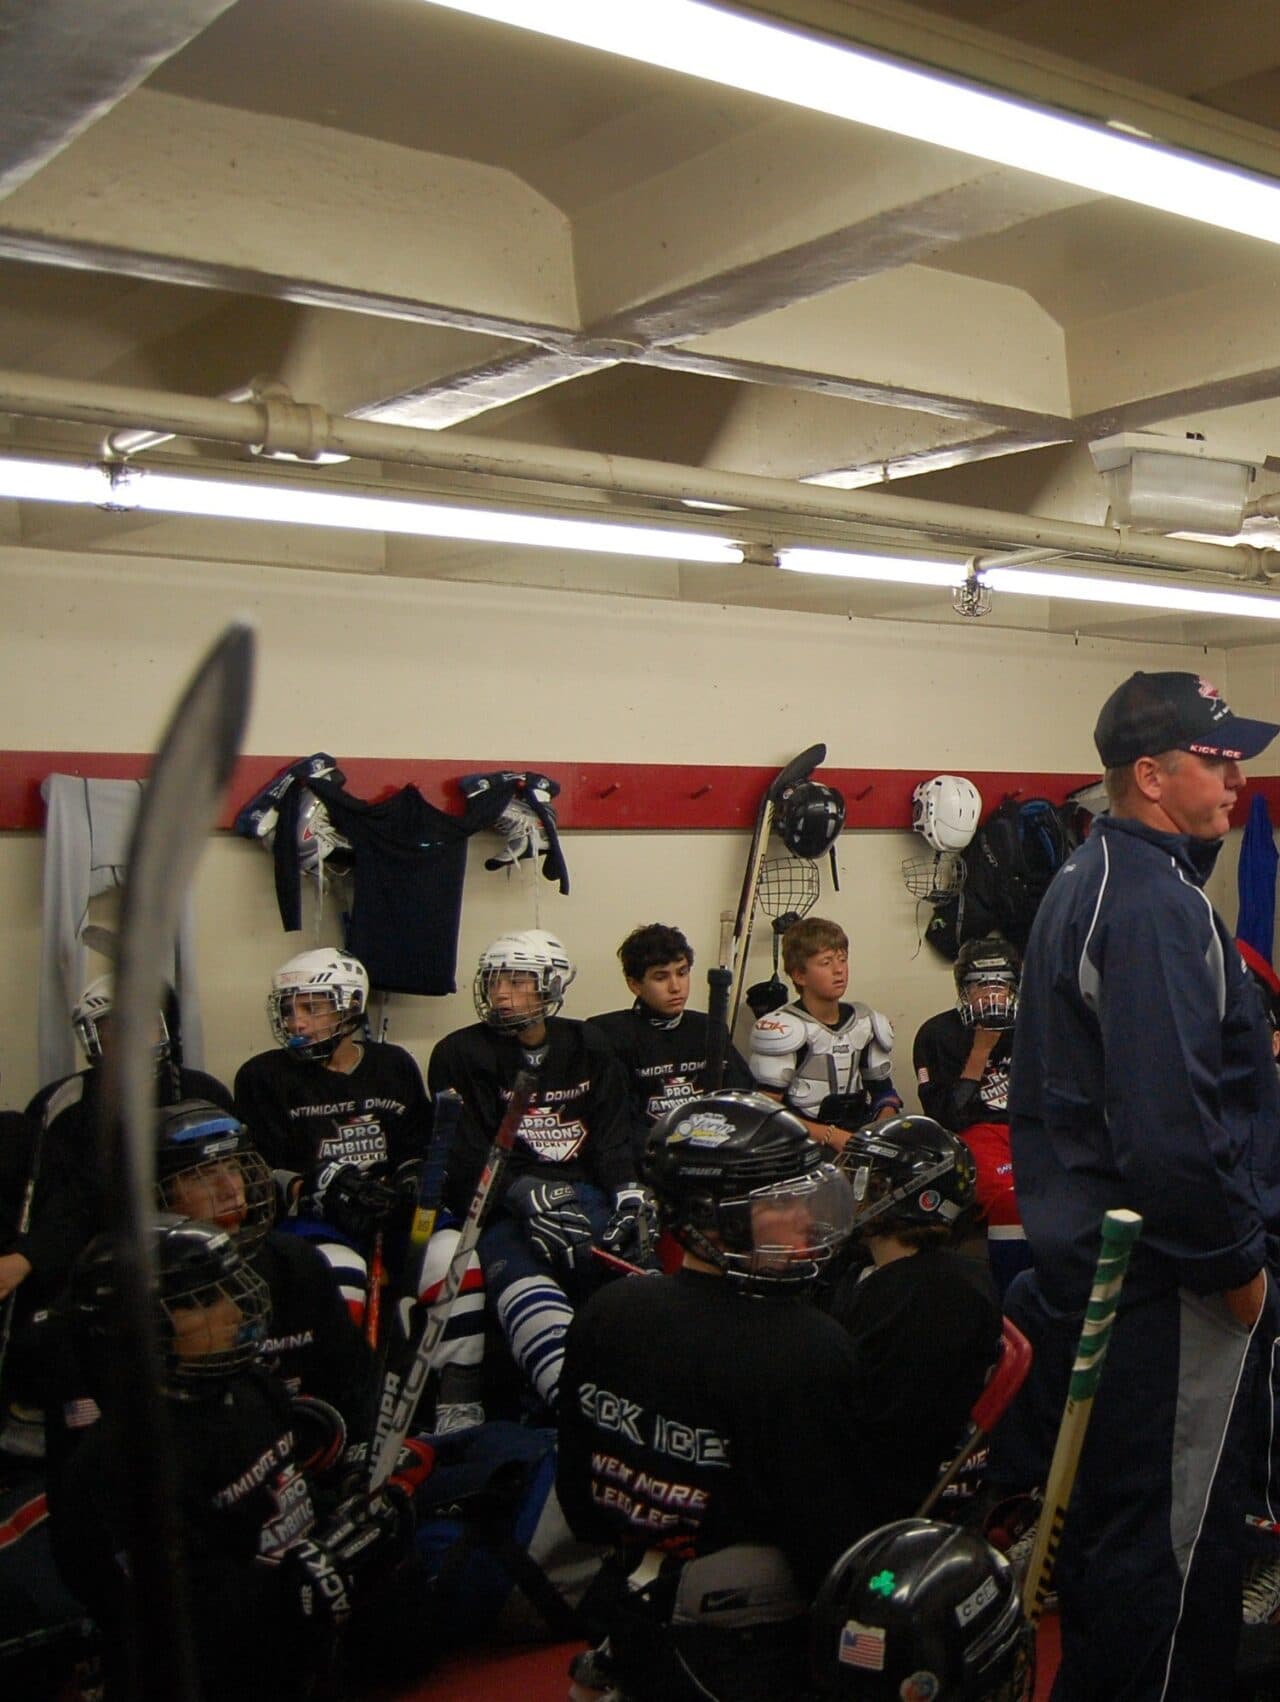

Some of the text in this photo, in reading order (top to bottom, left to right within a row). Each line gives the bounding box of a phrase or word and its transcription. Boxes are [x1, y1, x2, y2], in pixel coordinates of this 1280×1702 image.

[1190, 744, 1243, 760] KICK ICE
[525, 1117, 556, 1129] PRO
[343, 1123, 382, 1140] PRO
[653, 1413, 733, 1469] ICE
